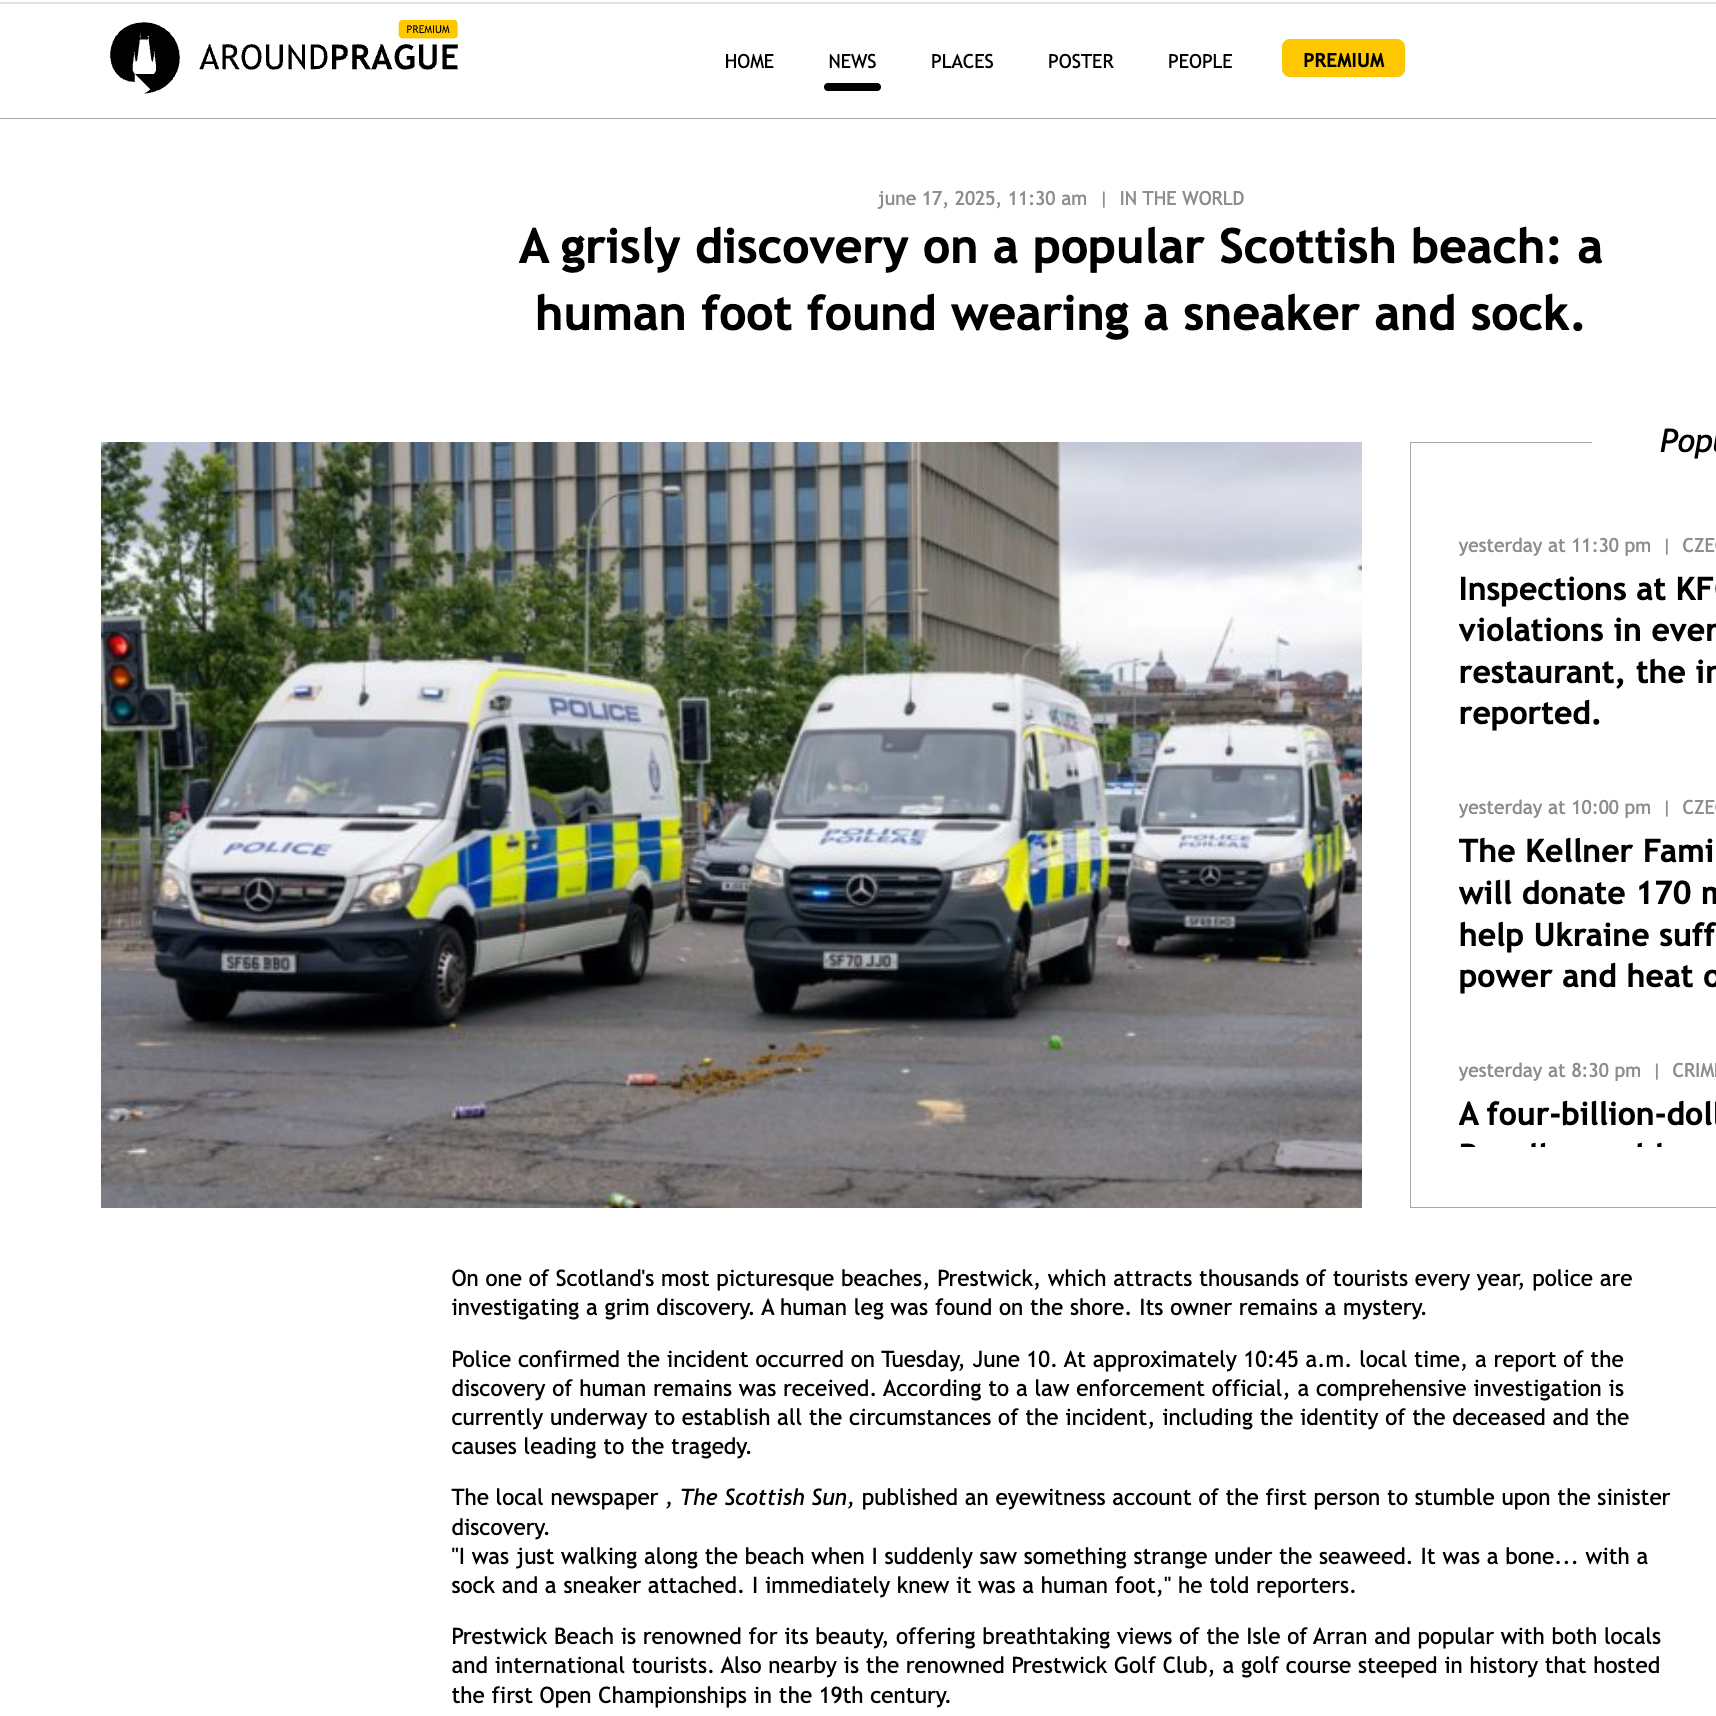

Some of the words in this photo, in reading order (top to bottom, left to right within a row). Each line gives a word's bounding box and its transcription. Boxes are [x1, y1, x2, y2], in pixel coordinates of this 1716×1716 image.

[406, 24, 450, 34] PREMIUM
[198, 43, 459, 71] AROUNDPRAGUE
[725, 53, 774, 69] HOME
[829, 53, 877, 69] NEWS
[931, 53, 994, 69] PLACES
[1048, 53, 1115, 69] POSTER
[1168, 53, 1233, 69] PEOPLE
[1304, 52, 1385, 68] PREMIUM
[877, 190, 917, 210] june
[923, 190, 948, 209] 17,
[954, 190, 1001, 209] 2025,
[1009, 190, 1056, 206] 11:30
[1061, 193, 1087, 206] am
[1120, 190, 1137, 206] IN
[1141, 190, 1177, 206] THE
[1181, 190, 1245, 206] WORLD
[518, 226, 551, 264] A
[561, 225, 681, 274] grisly
[696, 225, 910, 274] discovery
[923, 236, 977, 265] on
[993, 236, 1019, 265] a
[1034, 226, 1206, 274] popular
[1220, 226, 1395, 265] Scottish
[1412, 225, 1559, 265] beach:
[1578, 236, 1603, 265] a
[537, 292, 685, 332] human
[701, 293, 793, 332] foot
[806, 292, 935, 332] found
[950, 293, 1130, 341] wearing
[1144, 303, 1169, 332] a
[1184, 293, 1361, 332] sneaker
[1375, 293, 1455, 332] and
[1471, 292, 1583, 332] sock.
[1659, 427, 1716, 460] Pop
[1458, 536, 1543, 557] yesterday
[1547, 538, 1566, 553] at
[1572, 537, 1620, 553] 11:30
[1624, 540, 1651, 557] pm
[1682, 537, 1716, 553] CZE
[1460, 575, 1627, 608] Inspections
[1636, 577, 1667, 602] at
[1677, 575, 1716, 601] KF
[1458, 615, 1604, 643] violations
[1613, 616, 1641, 642] in
[1459, 660, 1624, 690] restaurant,
[1635, 658, 1686, 685] the
[549, 696, 641, 723] POLICE
[1459, 698, 1601, 732] reported.
[1458, 798, 1543, 819] yesterday
[1547, 800, 1566, 815] at
[1572, 799, 1620, 815] 10:00
[1624, 802, 1651, 819] pm
[1682, 799, 1716, 815] CZE
[825, 827, 928, 838] POLICE
[1180, 833, 1251, 841] POLICE
[222, 841, 333, 857] POLICE
[1458, 837, 1516, 864] The
[1526, 837, 1634, 864] Kellner
[1644, 837, 1714, 864] Fami
[1458, 878, 1513, 906] will
[1522, 879, 1626, 906] donate
[1638, 879, 1692, 906] 170
[1459, 920, 1524, 954] help
[1535, 921, 1650, 948] Ukraine
[226, 955, 261, 970] SF66
[828, 953, 863, 968] SF70
[1459, 968, 1554, 995] power
[1562, 961, 1617, 989] and
[1627, 962, 1694, 989] heat
[1458, 1061, 1543, 1082] yesterday
[1547, 1063, 1566, 1078] at
[1571, 1062, 1610, 1078] 8:30
[1614, 1065, 1641, 1082] pm
[1672, 1062, 1716, 1078] CRIM
[1458, 1100, 1480, 1126] A
[1486, 1099, 1716, 1127] four-billion-dol
[451, 1268, 479, 1287] On
[485, 1273, 522, 1287] one
[528, 1268, 550, 1287] of
[555, 1268, 655, 1287] Scotland's
[661, 1270, 710, 1287] most
[716, 1269, 835, 1292] picturesque
[841, 1268, 929, 1291] beaches,
[938, 1268, 1040, 1291] Prestwick,
[1047, 1268, 1106, 1287] which
[1113, 1270, 1193, 1287] attracts
[1199, 1268, 1300, 1287] thousands
[1305, 1268, 1327, 1287] of
[1332, 1269, 1409, 1287] tourists
[1414, 1273, 1471, 1292] every
[1476, 1273, 1524, 1292] year,
[1532, 1268, 1593, 1292] police
[1599, 1273, 1633, 1287] are
[451, 1298, 580, 1321] investigating
[586, 1302, 598, 1316] a
[604, 1298, 649, 1321] grim
[656, 1297, 754, 1321] discovery.
[760, 1298, 776, 1316] A
[780, 1297, 847, 1316] human
[854, 1297, 885, 1321] leg
[890, 1302, 929, 1316] was
[934, 1297, 992, 1316] found
[999, 1302, 1023, 1316] on
[1030, 1297, 1064, 1316] the
[1070, 1297, 1131, 1316] shore.
[1140, 1298, 1164, 1316] Its
[1170, 1302, 1233, 1316] owner
[1239, 1298, 1318, 1316] remains
[1324, 1302, 1337, 1316] a
[1343, 1299, 1426, 1321] mystery.
[451, 1441, 517, 1455] causes
[524, 1436, 597, 1460] leading
[603, 1438, 625, 1455] to
[631, 1436, 665, 1455] the
[671, 1436, 751, 1460] tragedy.
[451, 1517, 549, 1541] discovery.
[451, 1575, 496, 1594] sock
[501, 1575, 538, 1594] and
[544, 1580, 557, 1594] a
[563, 1575, 642, 1594] sneaker
[647, 1575, 744, 1594] attached.
[753, 1576, 757, 1594] I
[765, 1575, 891, 1599] immediately
[897, 1575, 950, 1594] knew
[956, 1576, 972, 1594] it
[977, 1580, 1016, 1594] was
[1022, 1580, 1034, 1594] a
[1041, 1575, 1108, 1594] human
[1114, 1575, 1172, 1598] foot,"
[1178, 1575, 1203, 1594] he
[1209, 1575, 1249, 1594] told
[1256, 1577, 1356, 1599] reporters.
[451, 1685, 485, 1704] the
[491, 1685, 534, 1704] first
[539, 1685, 591, 1709] Open
[598, 1685, 747, 1709] Championships
[753, 1686, 772, 1704] in
[778, 1685, 813, 1704] the
[820, 1685, 863, 1704] 19th
[870, 1687, 951, 1709] century.
